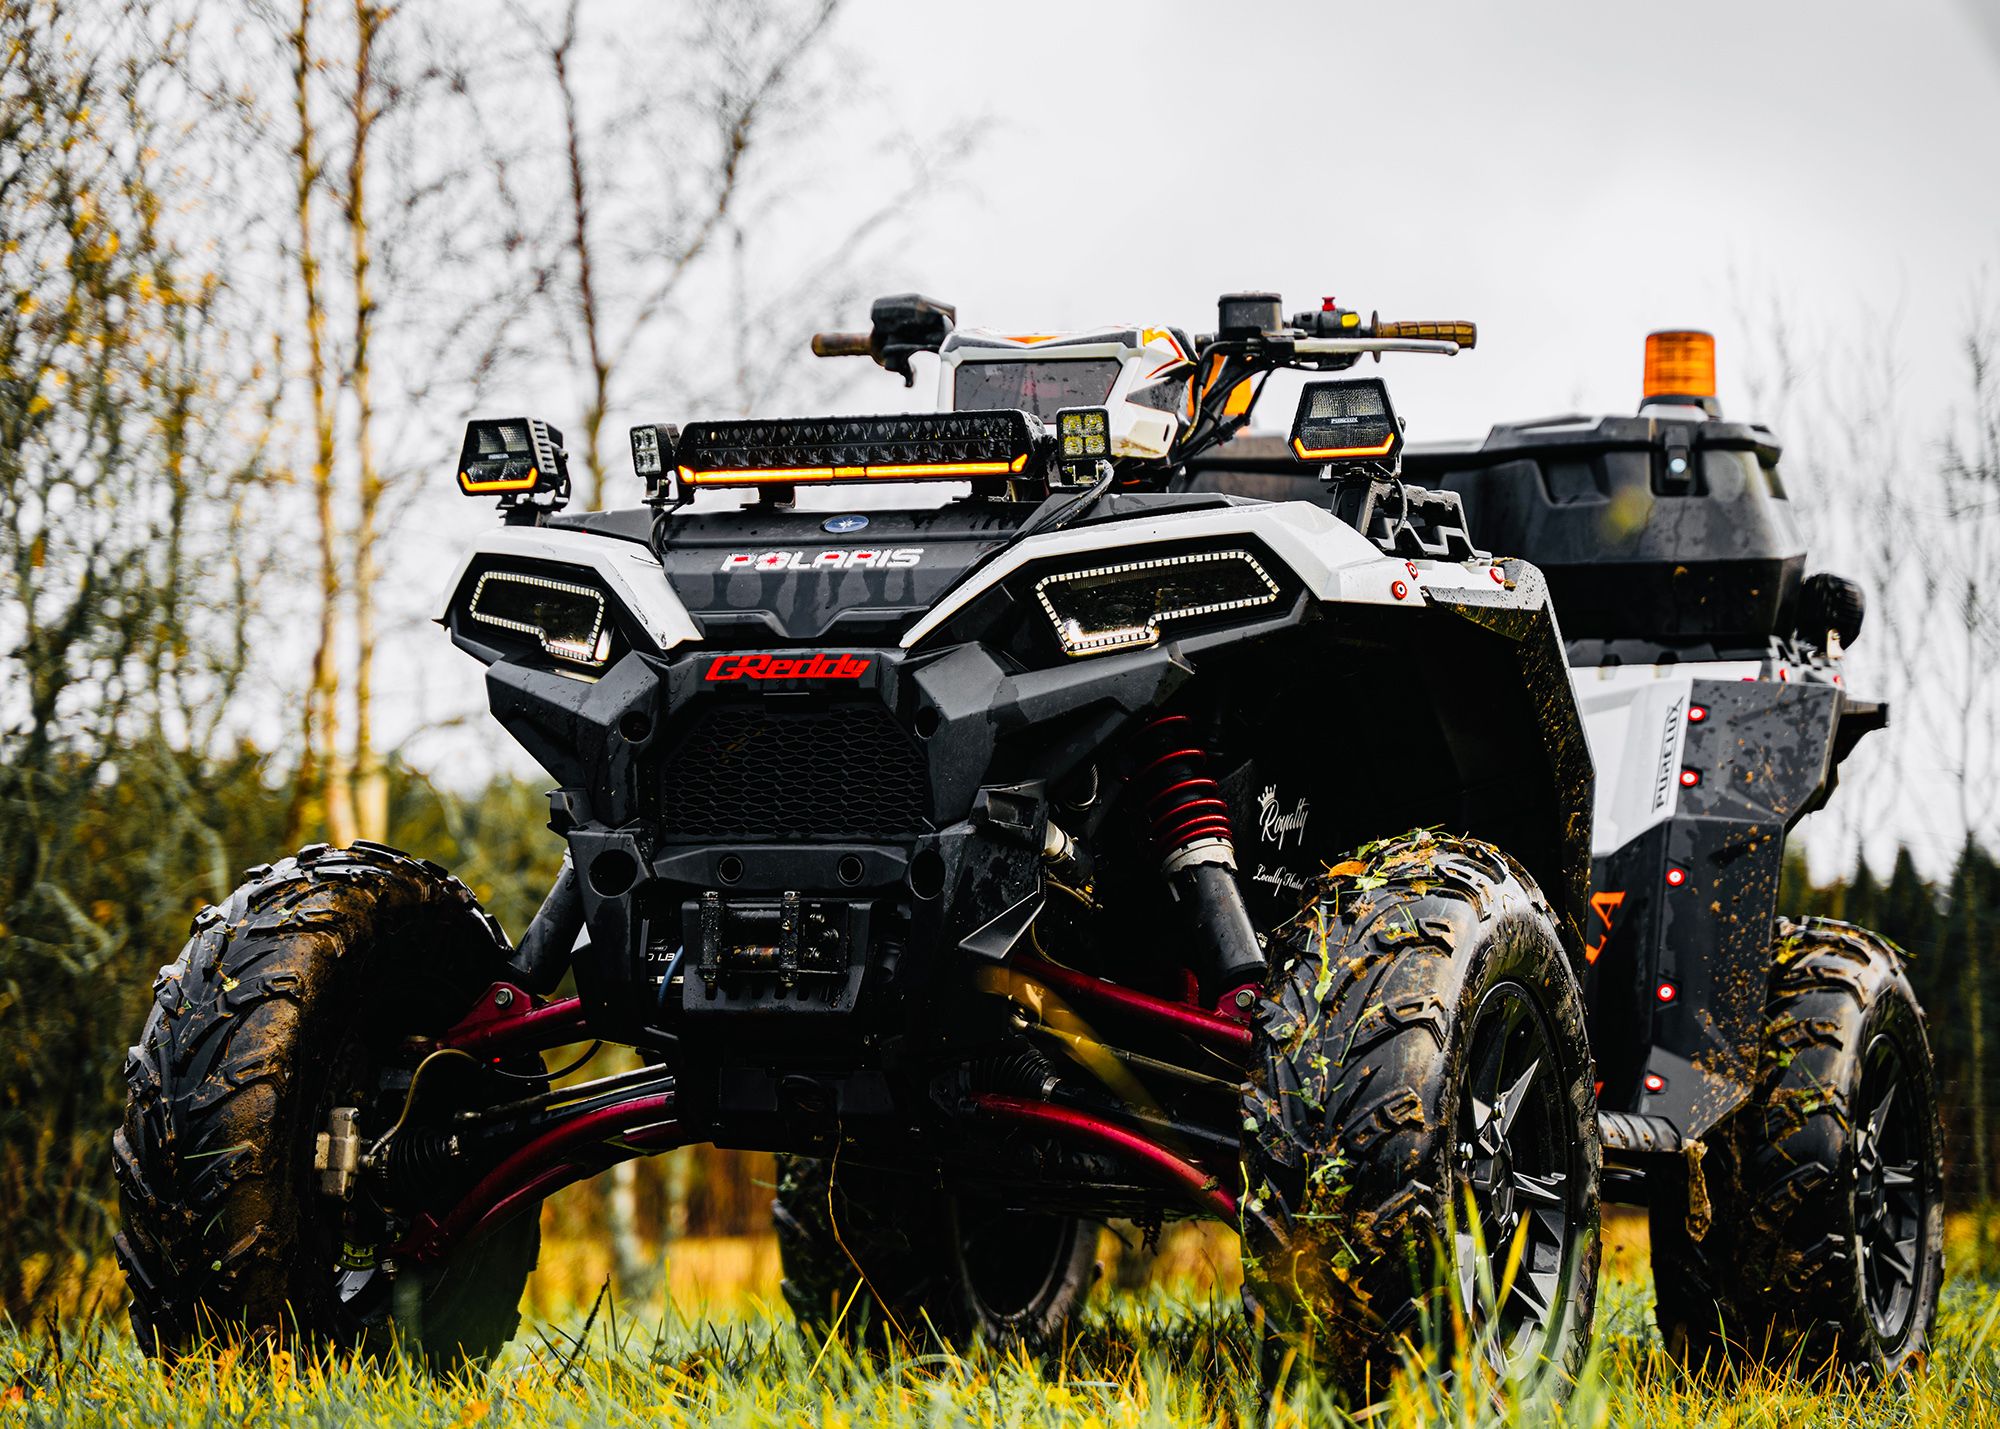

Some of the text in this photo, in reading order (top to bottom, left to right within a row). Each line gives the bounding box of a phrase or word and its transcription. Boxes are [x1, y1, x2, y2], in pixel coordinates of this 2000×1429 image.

[720, 548, 924, 572] POLARIS
[1259, 798, 1310, 850] Royalty
[1253, 863, 1309, 897] Locally Hated
